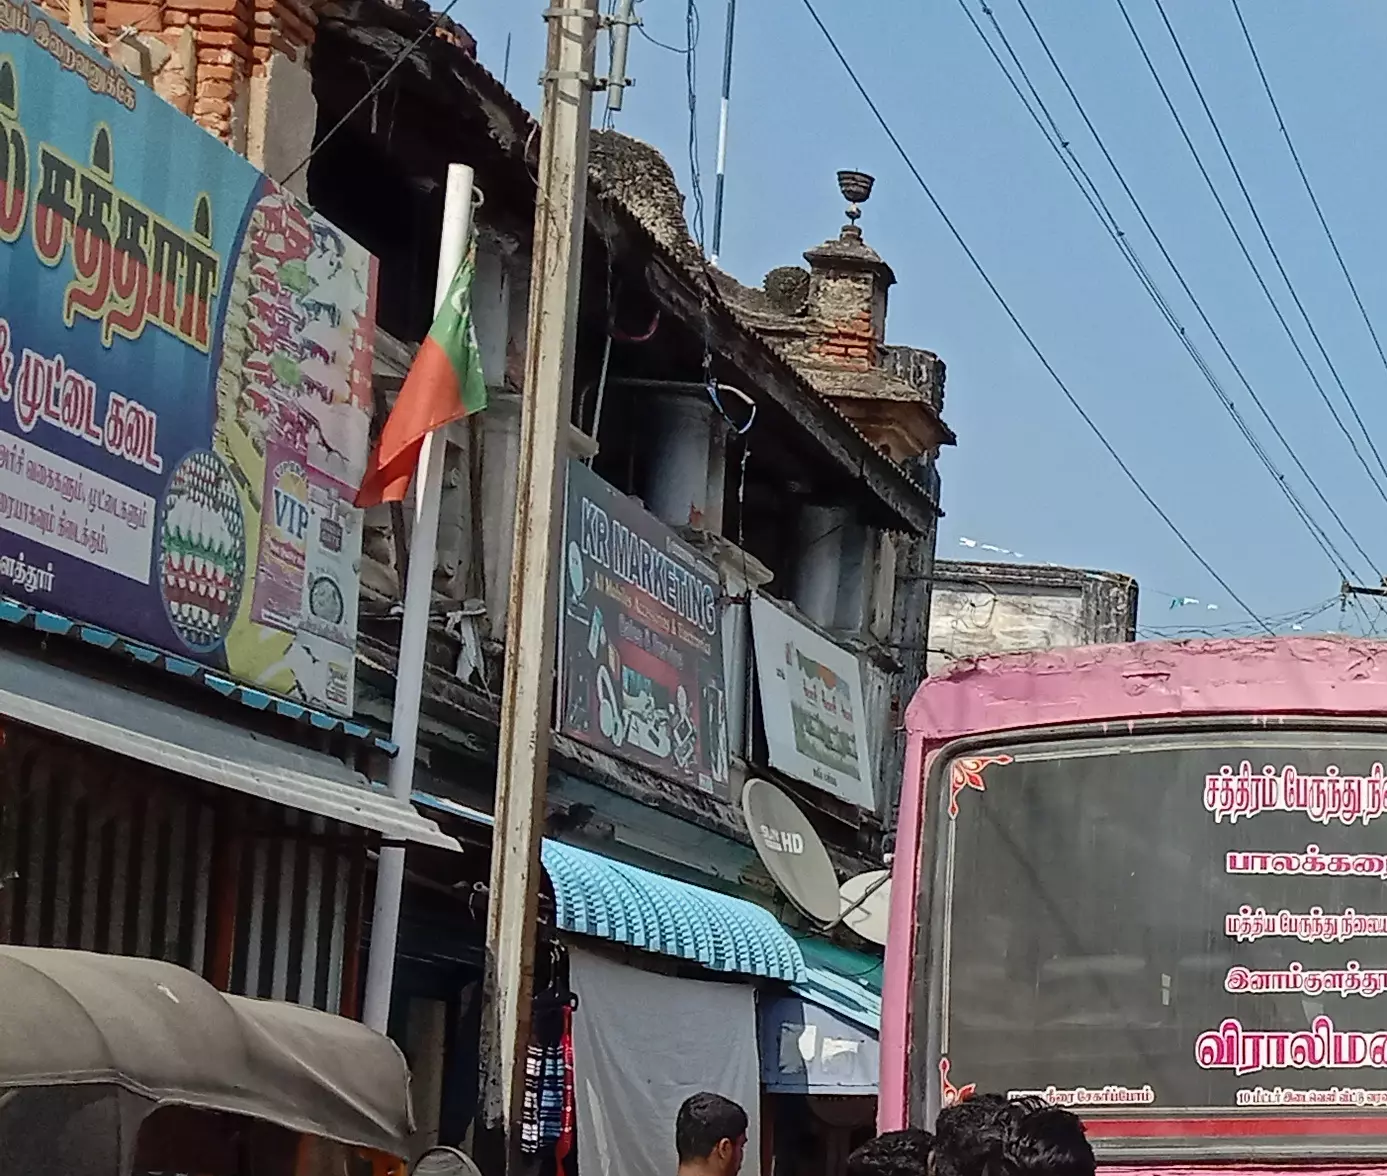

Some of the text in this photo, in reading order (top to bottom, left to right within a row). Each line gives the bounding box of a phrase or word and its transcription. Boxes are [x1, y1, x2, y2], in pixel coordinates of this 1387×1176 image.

[34, 122, 219, 353] சத்தார்
[15, 349, 102, 445] முட்டை
[105, 392, 162, 474] கடை
[273, 487, 309, 539] VIP
[581, 496, 610, 569] KR
[612, 519, 716, 635] MARKETING
[1204, 760, 1277, 824] சத்திரம்
[1283, 764, 1361, 825] பேருந்து
[780, 831, 804, 854] HD
[1225, 905, 1277, 942] மத்திய
[1279, 906, 1341, 943] பேருந்து
[1237, 1090, 1250, 1105] 10
